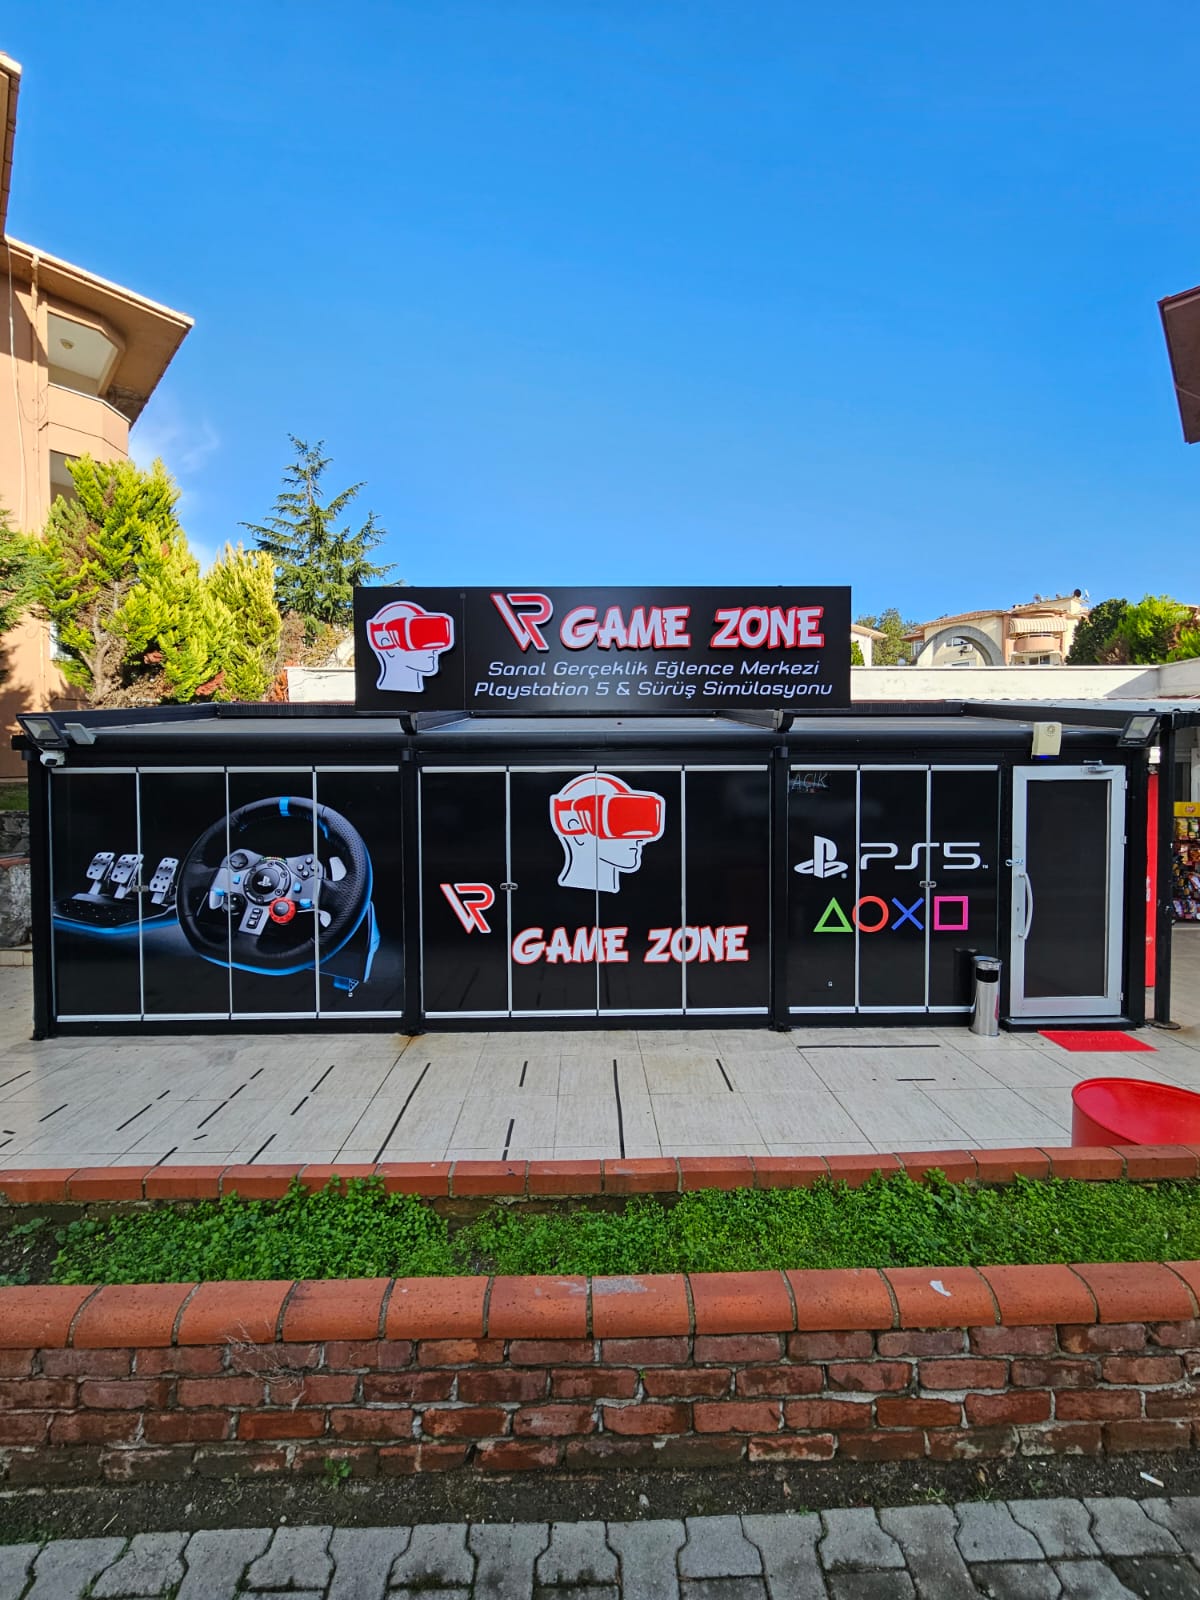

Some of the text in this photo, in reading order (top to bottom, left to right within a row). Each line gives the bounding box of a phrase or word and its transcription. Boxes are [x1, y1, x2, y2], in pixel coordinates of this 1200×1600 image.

[490, 592, 825, 651] VR GAME ZONE
[488, 660, 821, 679] Sanal Gerçeklik Eğlence Merkezi
[474, 680, 833, 700] Playstation 5 & Sürüş Simülasyonu
[860, 842, 981, 870] PS5
[440, 883, 495, 934] VR
[512, 925, 749, 964] GAME ZONE
